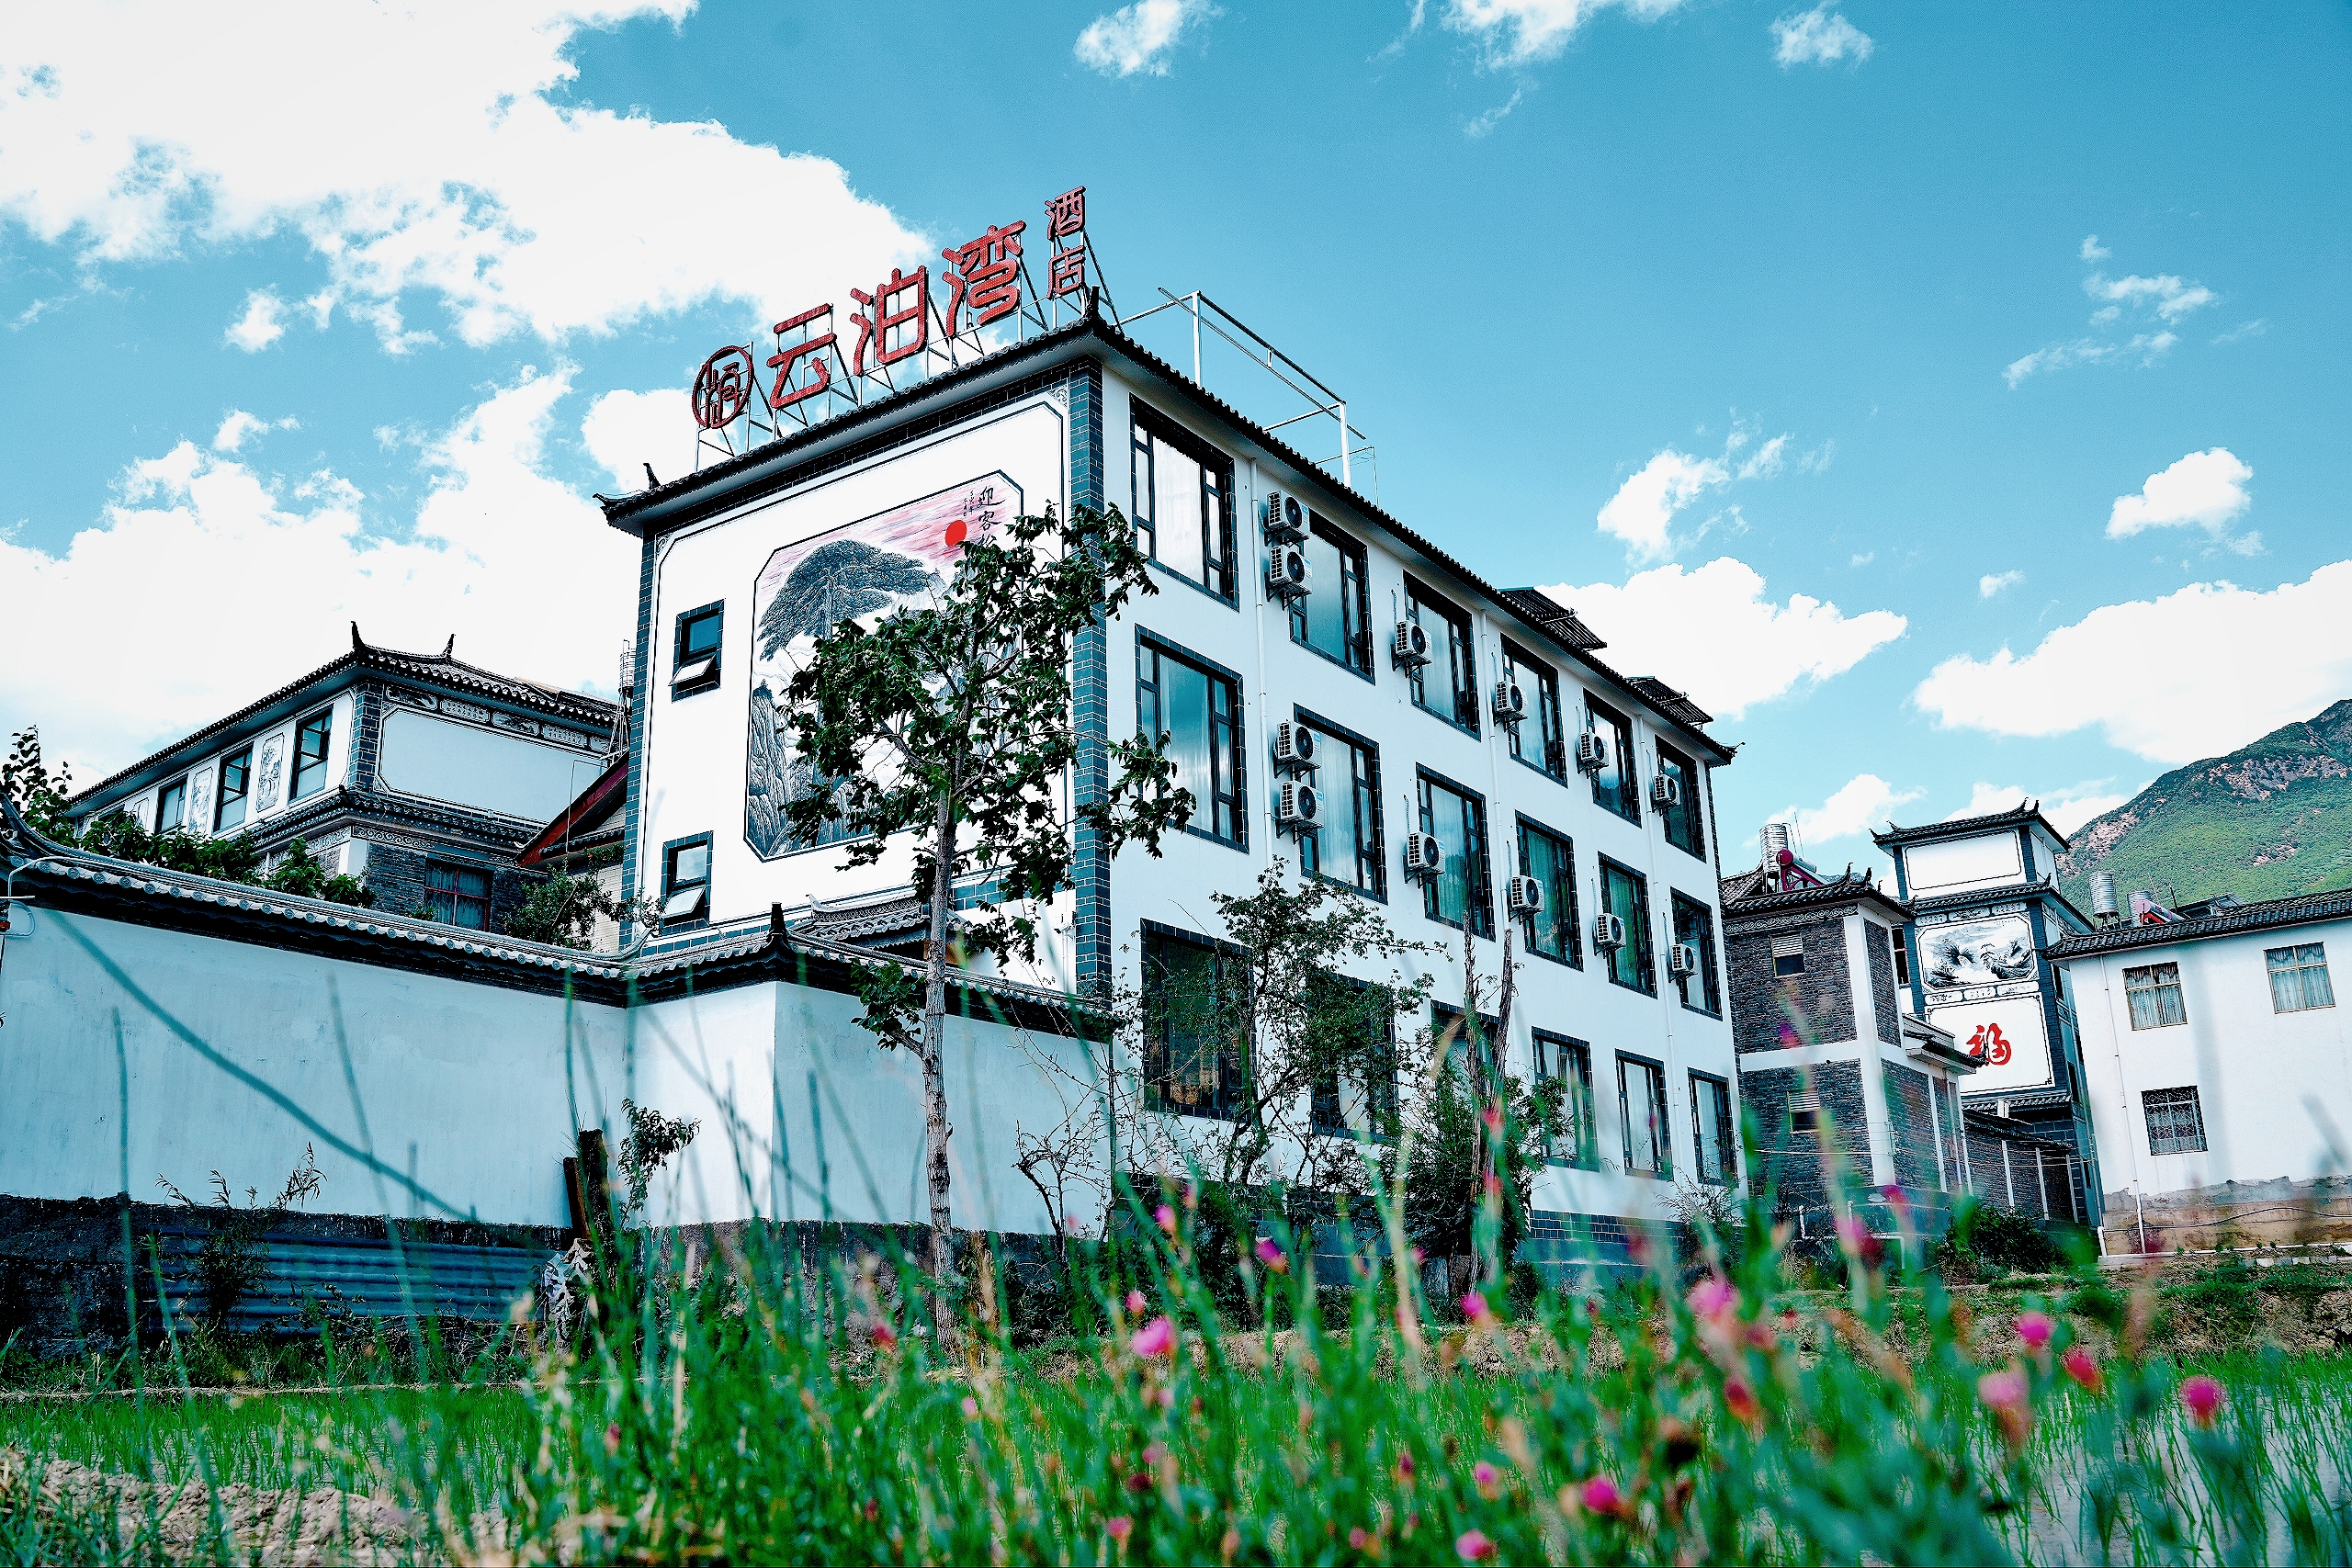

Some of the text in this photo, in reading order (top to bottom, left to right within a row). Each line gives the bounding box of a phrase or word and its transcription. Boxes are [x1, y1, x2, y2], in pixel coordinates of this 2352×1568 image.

[1045, 186, 1086, 299] 酒店
[766, 220, 1027, 409] 云泊湾
[1966, 1023, 2012, 1066] 福
